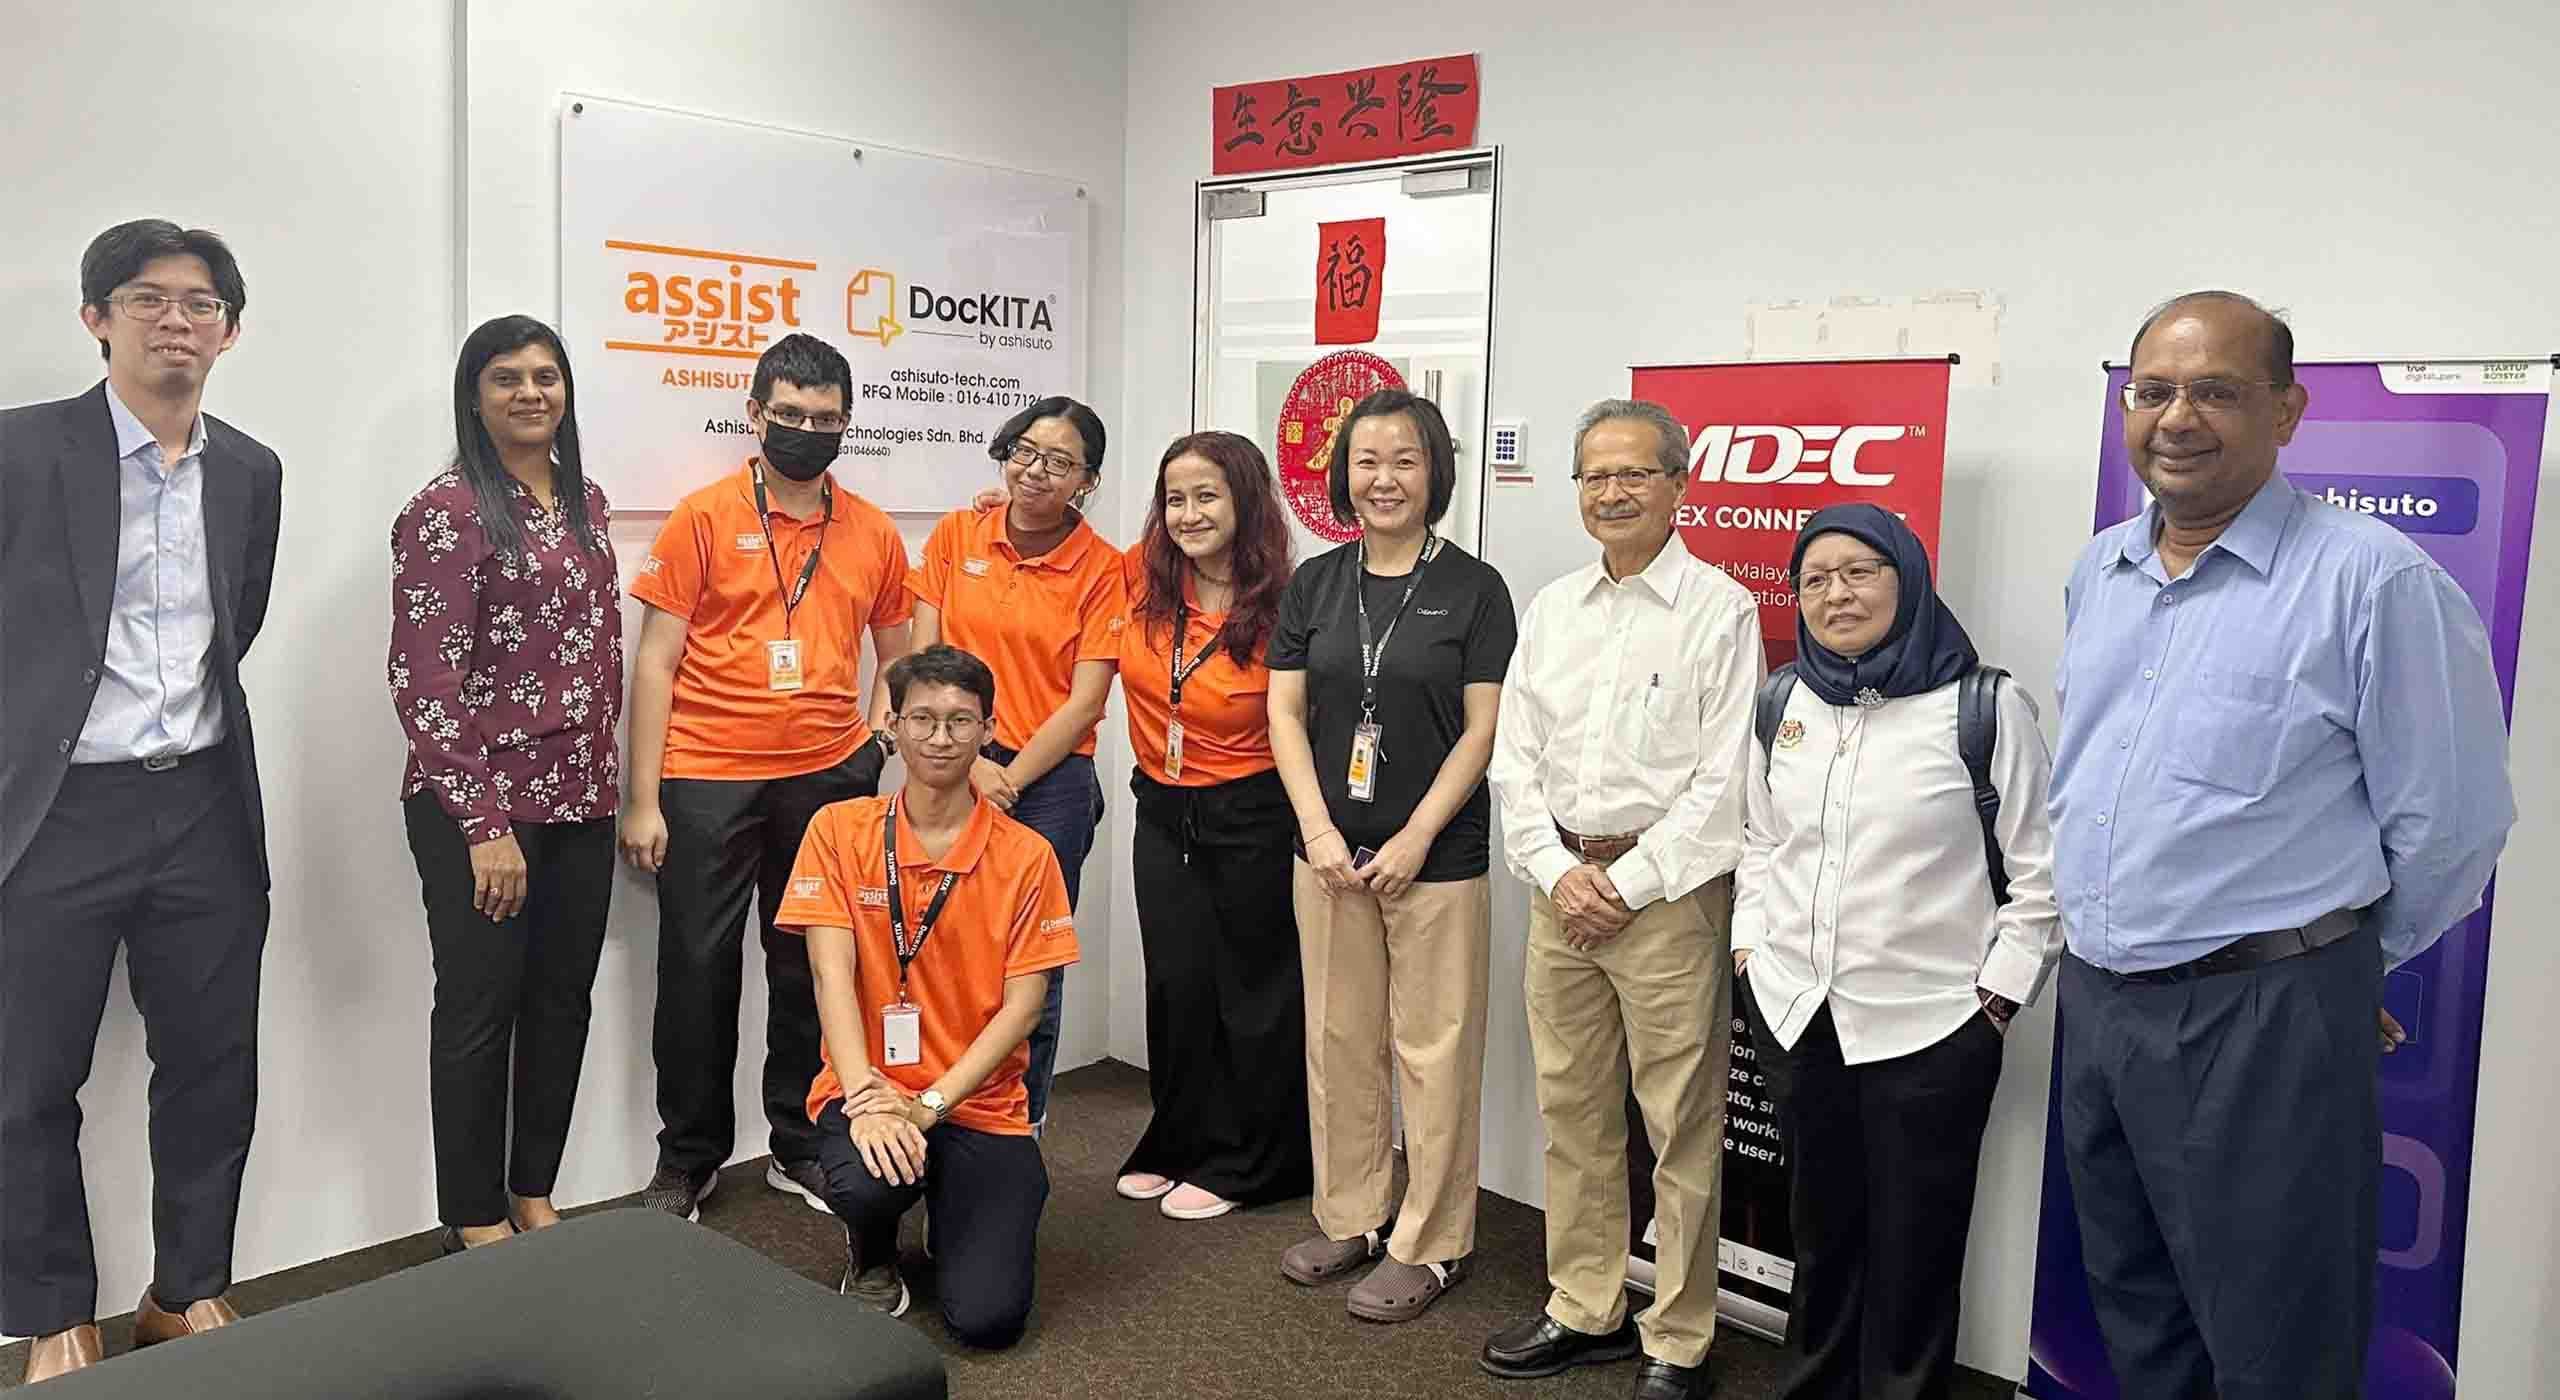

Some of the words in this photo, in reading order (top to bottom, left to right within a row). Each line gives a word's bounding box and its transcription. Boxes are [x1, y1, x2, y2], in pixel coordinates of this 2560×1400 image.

[1321, 234, 1373, 312] 福
[624, 264, 801, 327] assist
[664, 319, 769, 348] アシスト
[980, 332, 996, 349] by
[999, 335, 1053, 350] ashisuto
[662, 367, 752, 390] ASHISUT
[890, 368, 1020, 389] ashisuto-tech.com
[862, 384, 892, 399] RFQ
[896, 386, 945, 402] Mobile
[957, 390, 1010, 407] 016-410
[705, 418, 754, 435] Ashisu
[846, 425, 923, 443] chnologies
[927, 429, 955, 443] Sdn.
[959, 430, 987, 444] Bhd.
[1684, 424, 1905, 487] MDEC
[2314, 487, 2438, 517] hisuto
[1671, 504, 1708, 527] EX
[1715, 506, 1814, 531] CONNE
[1738, 1141, 1777, 1164] user
